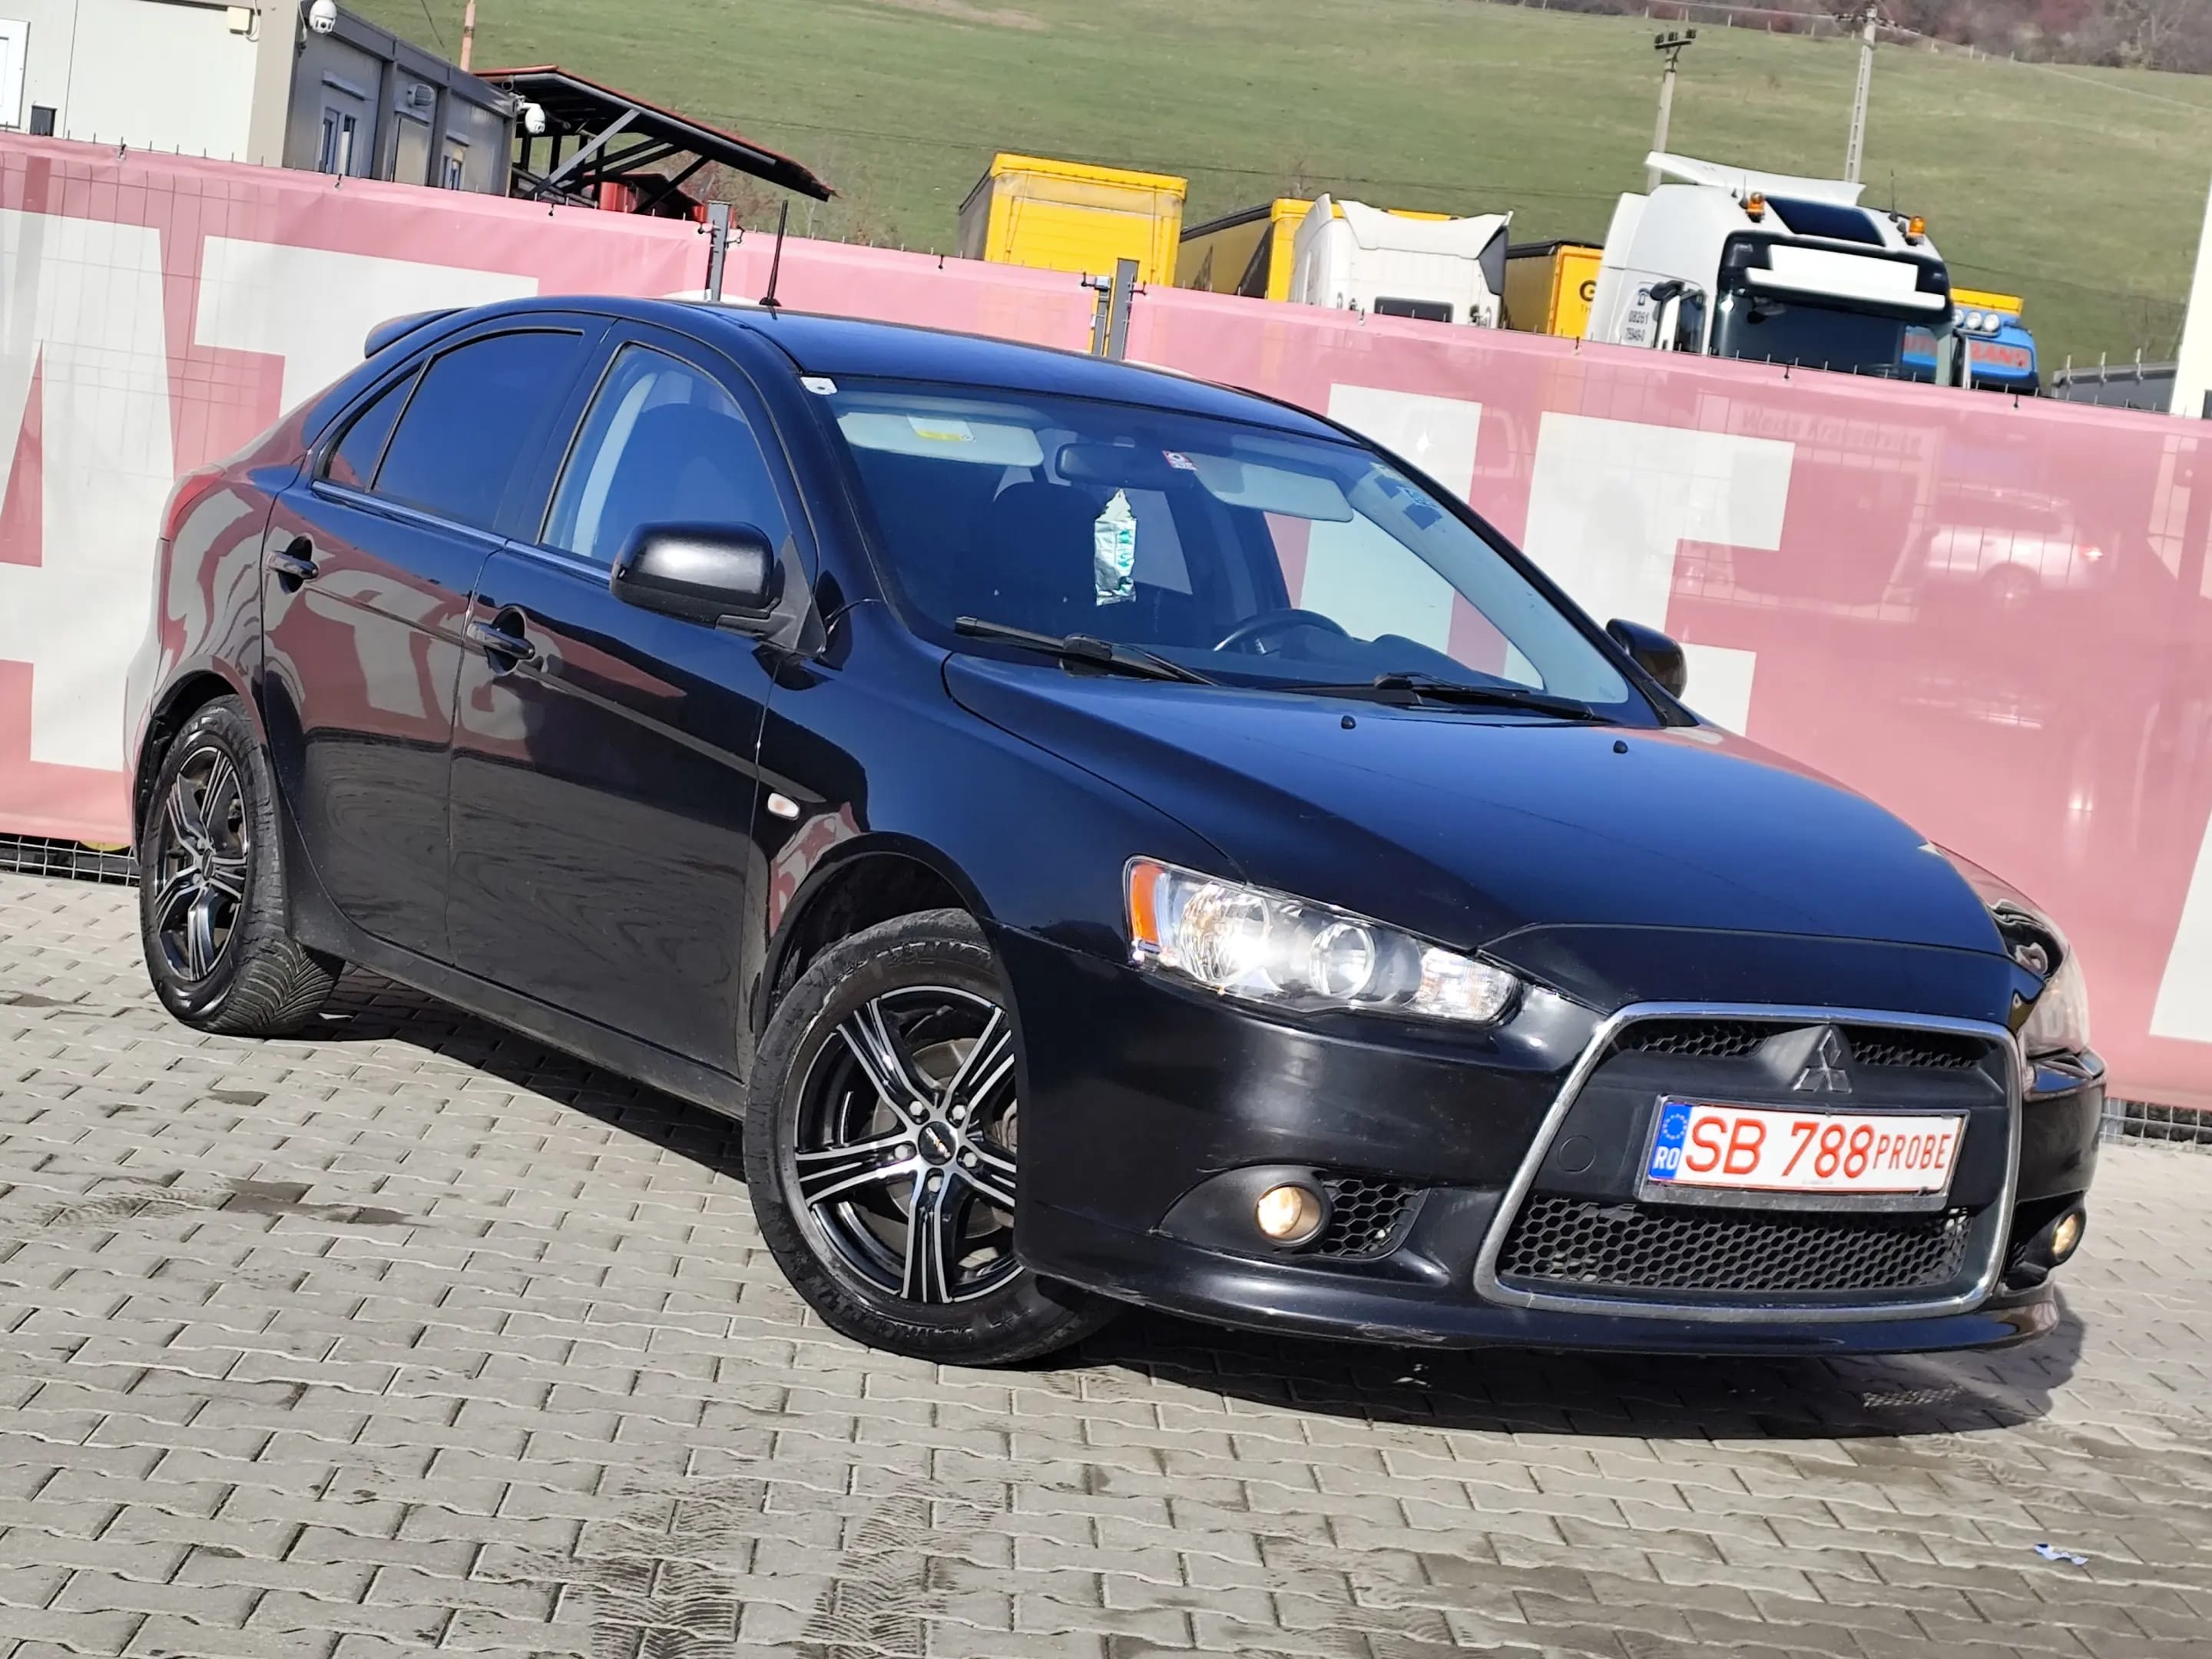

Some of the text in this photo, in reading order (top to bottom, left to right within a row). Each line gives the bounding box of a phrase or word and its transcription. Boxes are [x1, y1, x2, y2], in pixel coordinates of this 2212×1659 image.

[1653, 1146, 1680, 1171] RO
[1685, 1115, 1952, 1178] SB 788 PROBE
